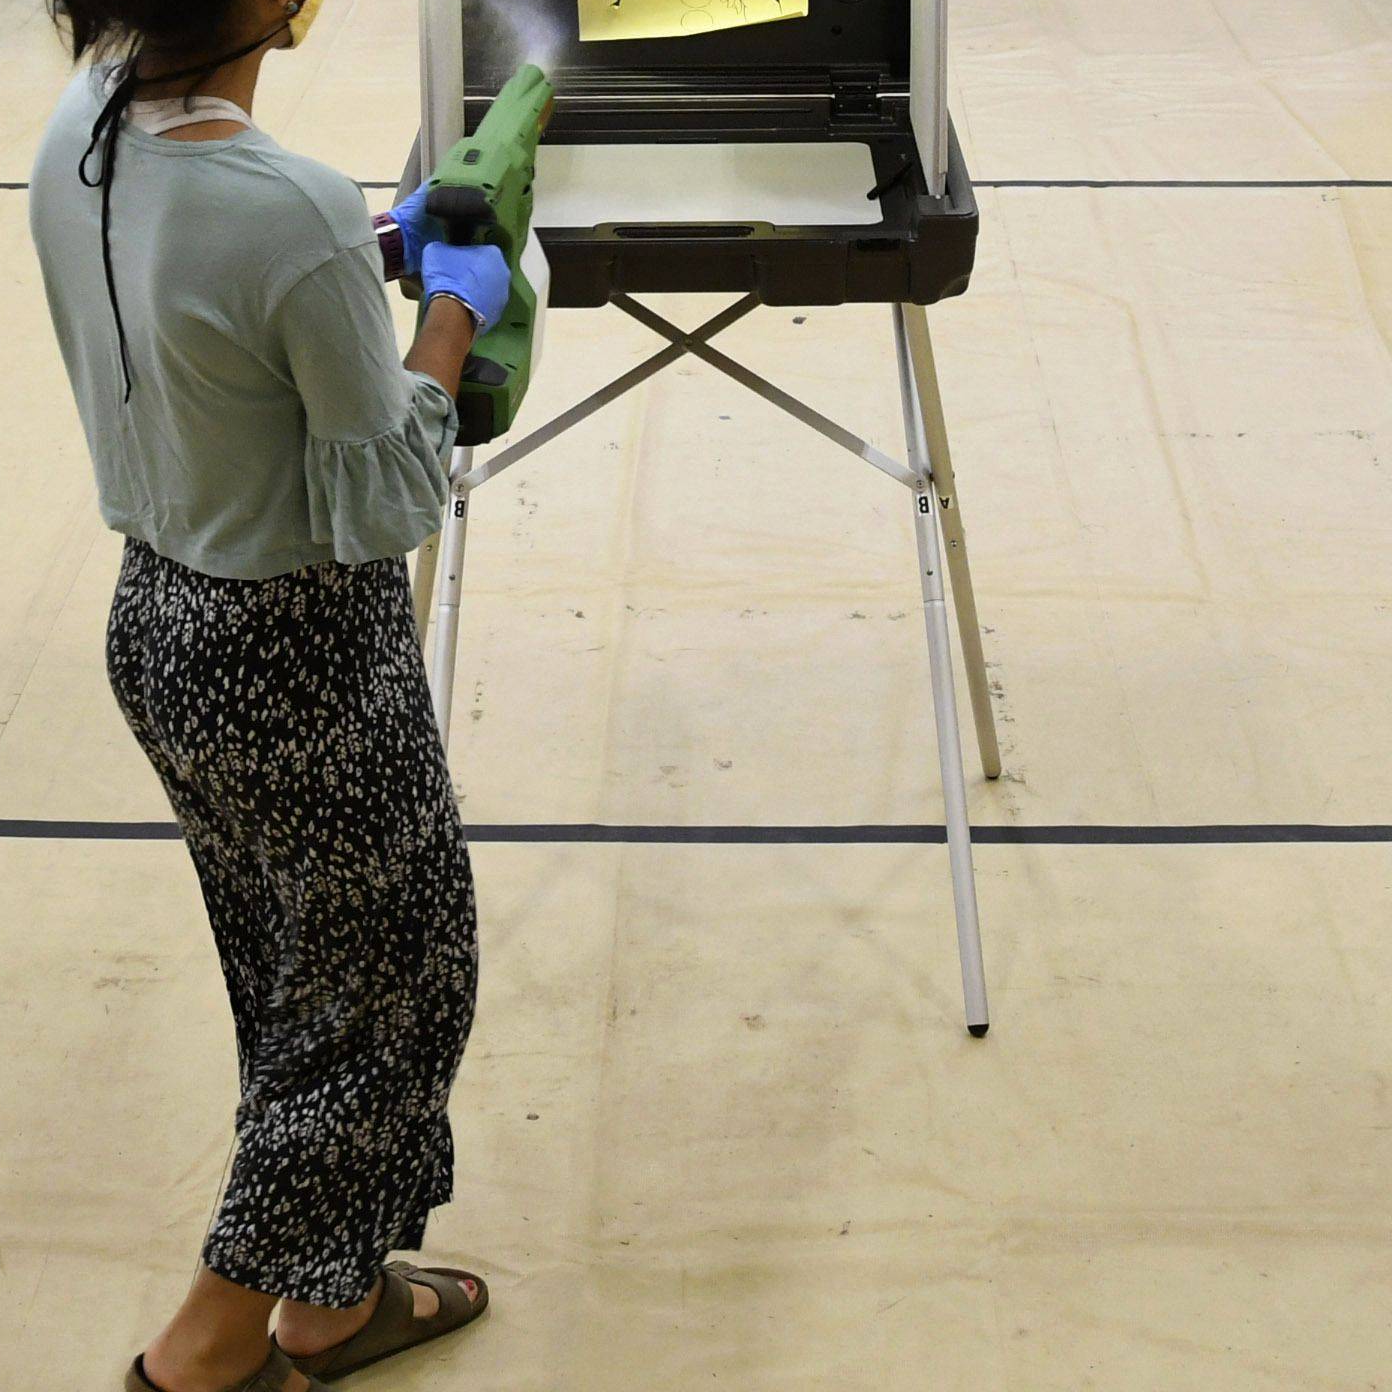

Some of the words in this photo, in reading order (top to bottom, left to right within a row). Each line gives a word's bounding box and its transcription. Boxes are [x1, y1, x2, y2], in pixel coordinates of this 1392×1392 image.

[454, 500, 465, 518] B
[918, 496, 930, 513] B
[938, 497, 950, 509] A
